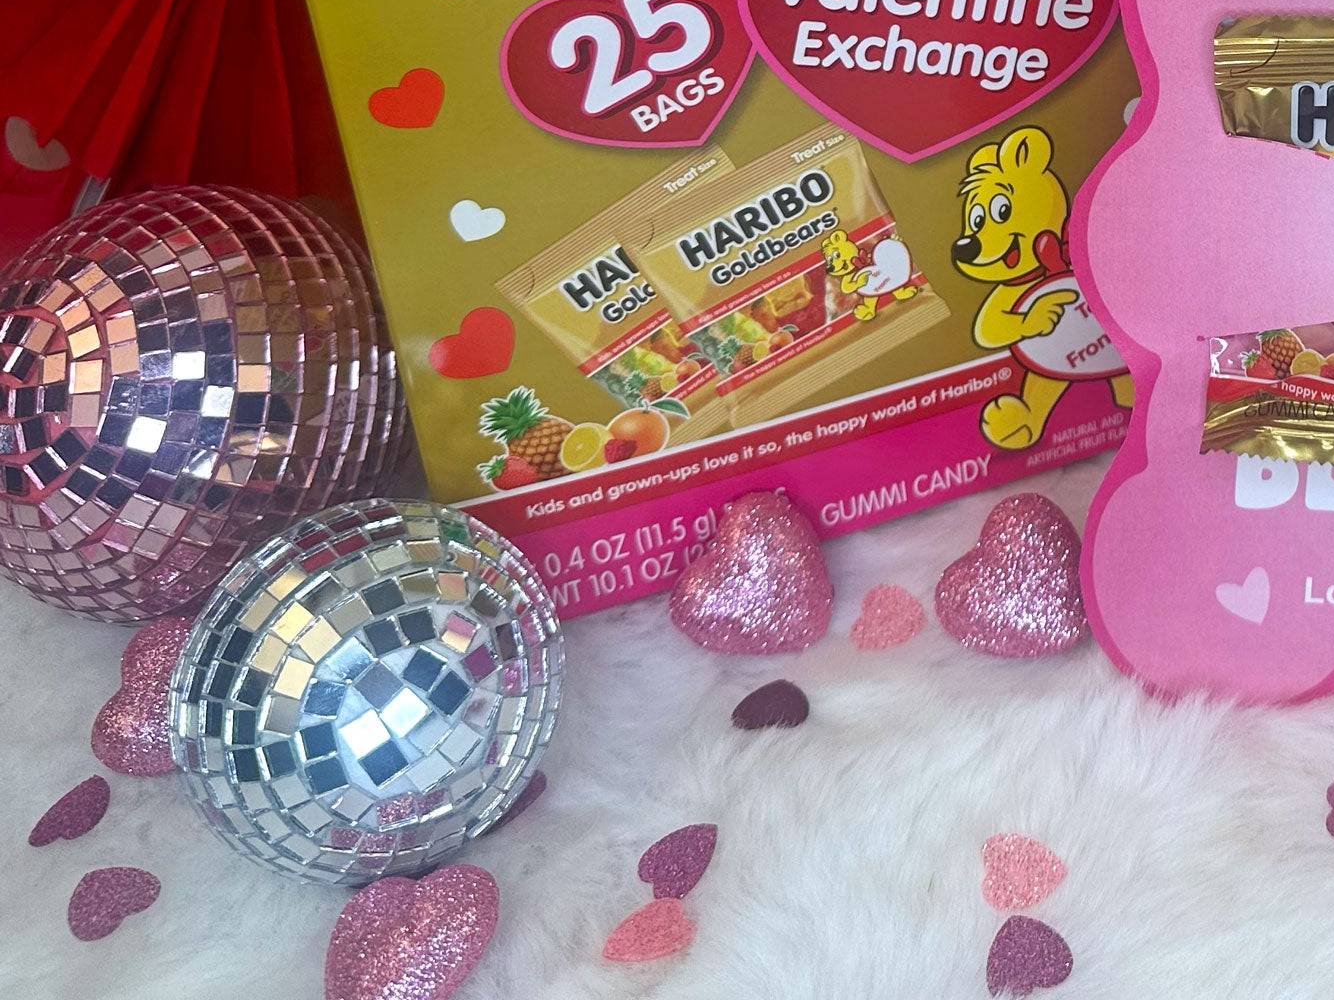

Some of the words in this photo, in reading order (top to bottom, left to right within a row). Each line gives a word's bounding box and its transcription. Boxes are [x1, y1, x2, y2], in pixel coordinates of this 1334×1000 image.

[793, 21, 1048, 90] Exchange
[631, 69, 724, 133] BAGS
[663, 167, 698, 194] Treat
[791, 140, 826, 164] Treat
[677, 168, 833, 271] HARIBO
[711, 209, 839, 286] Goldbears
[1101, 412, 1124, 429] AND
[1281, 381, 1318, 400] happy
[525, 498, 565, 521] Kids
[568, 487, 604, 507] and
[607, 463, 700, 501] grown-ups
[703, 451, 739, 471] love
[742, 445, 754, 459] it
[757, 441, 782, 455] so,
[785, 431, 813, 447] the
[816, 413, 868, 438] happy
[872, 399, 917, 422] world
[920, 391, 937, 406] of
[821, 480, 907, 526] GUMMI
[912, 453, 992, 498] CANDY
[544, 545, 585, 578] 0.4
[592, 533, 630, 564] OZ
[634, 516, 686, 554] (11.5
[694, 507, 717, 540] g)
[589, 565, 634, 596] 10.1
[640, 551, 678, 581] OZ
